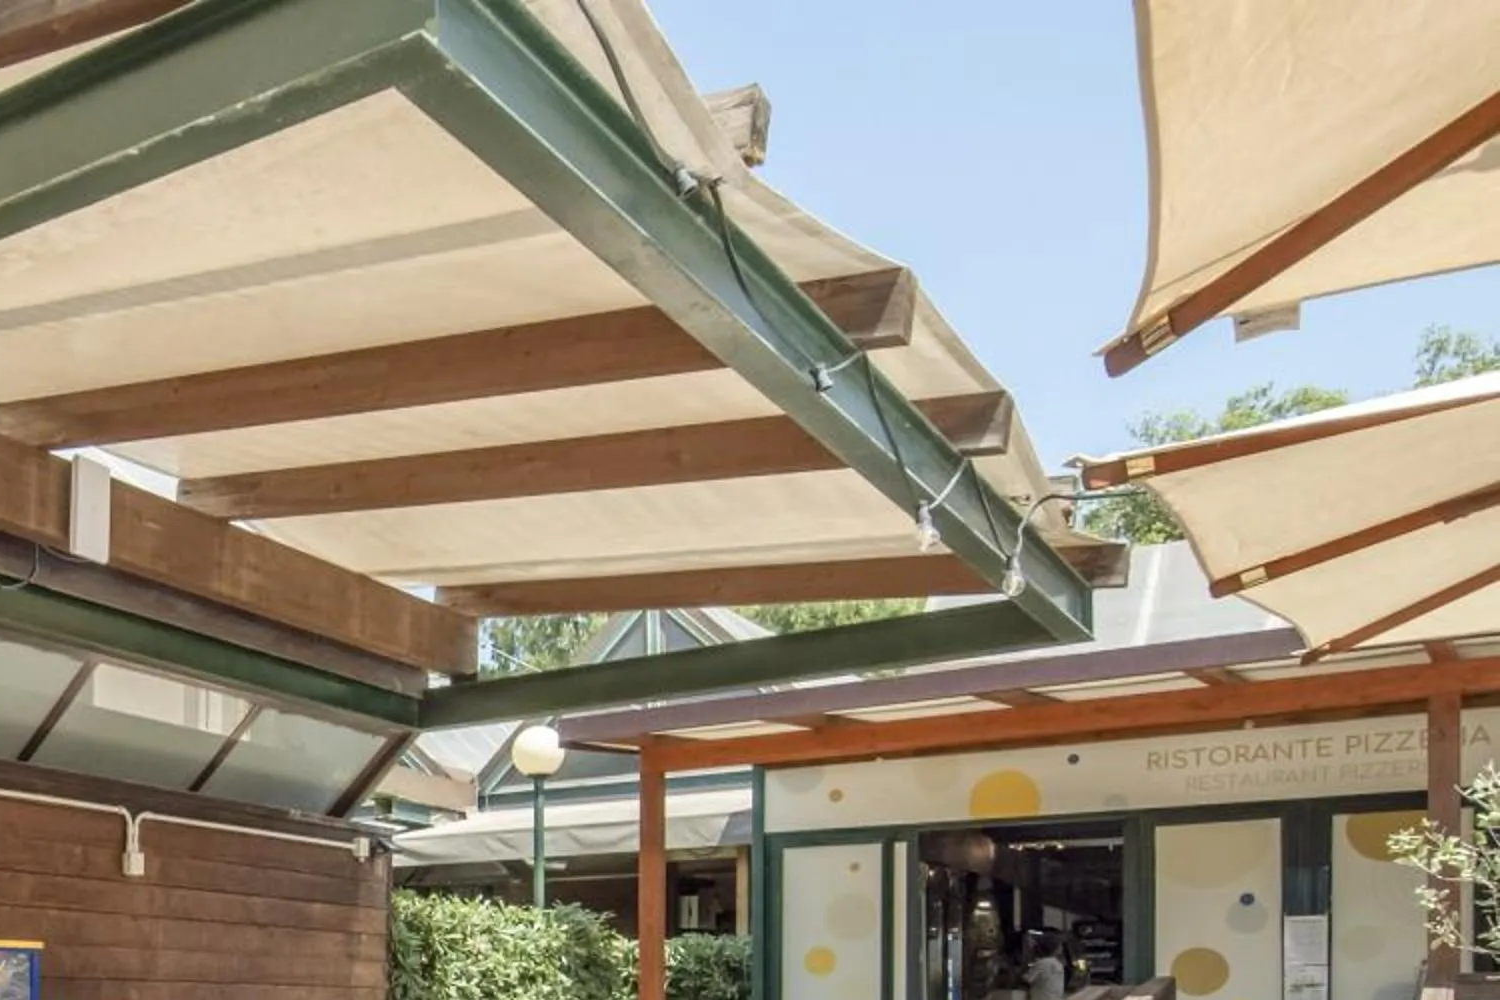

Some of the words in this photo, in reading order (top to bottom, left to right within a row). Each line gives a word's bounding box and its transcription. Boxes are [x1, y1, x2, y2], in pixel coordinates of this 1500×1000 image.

[1147, 736, 1333, 771] RISTORANTE
[1346, 725, 1491, 755] PIZZEIA
[1186, 764, 1336, 792] RESTAURANT
